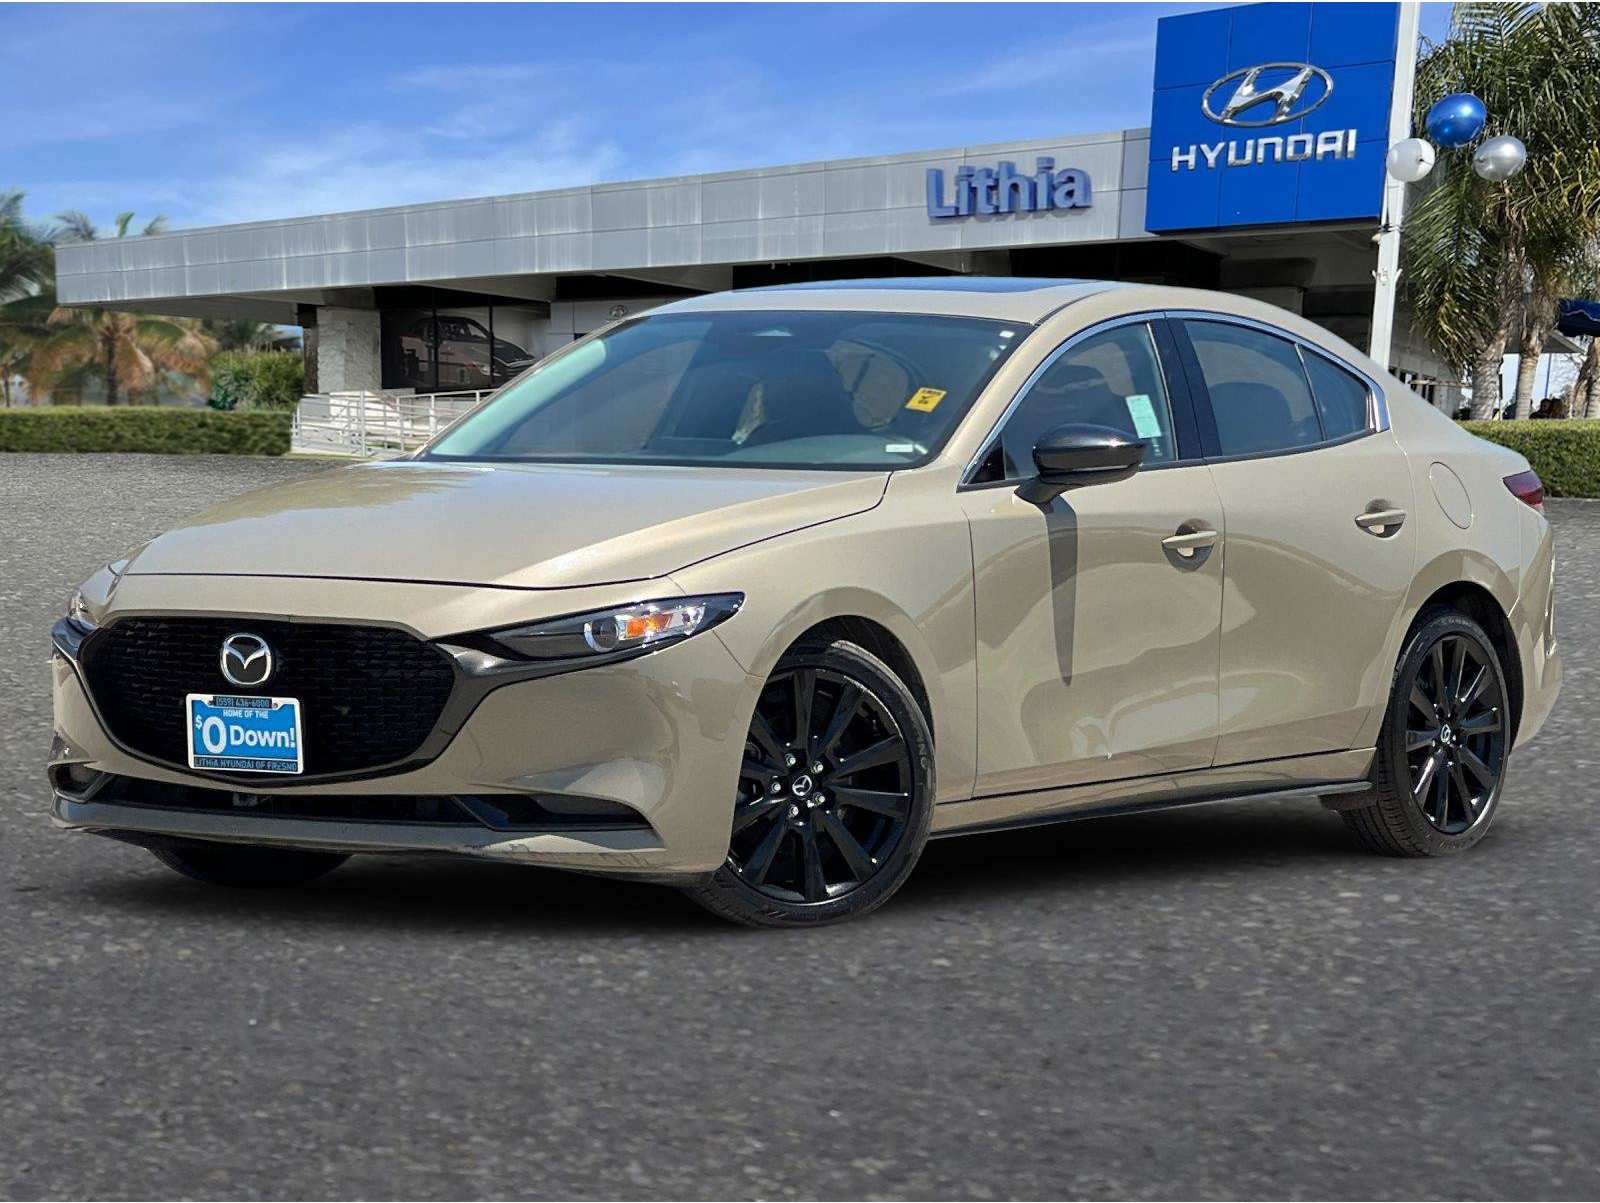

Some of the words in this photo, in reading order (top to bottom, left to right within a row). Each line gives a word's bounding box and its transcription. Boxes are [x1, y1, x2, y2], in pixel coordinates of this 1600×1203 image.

[1171, 128, 1357, 171] HYUNDAI
[926, 156, 1093, 218] Lithia
[223, 710, 242, 718] HOME
[245, 710, 253, 718] OF
[255, 710, 269, 719] THE
[229, 725, 296, 748] Down!
[194, 757, 219, 768] LITHIA
[220, 759, 254, 769] HYUNDAI
[255, 760, 266, 769] OF
[267, 760, 297, 771] FRESNO
